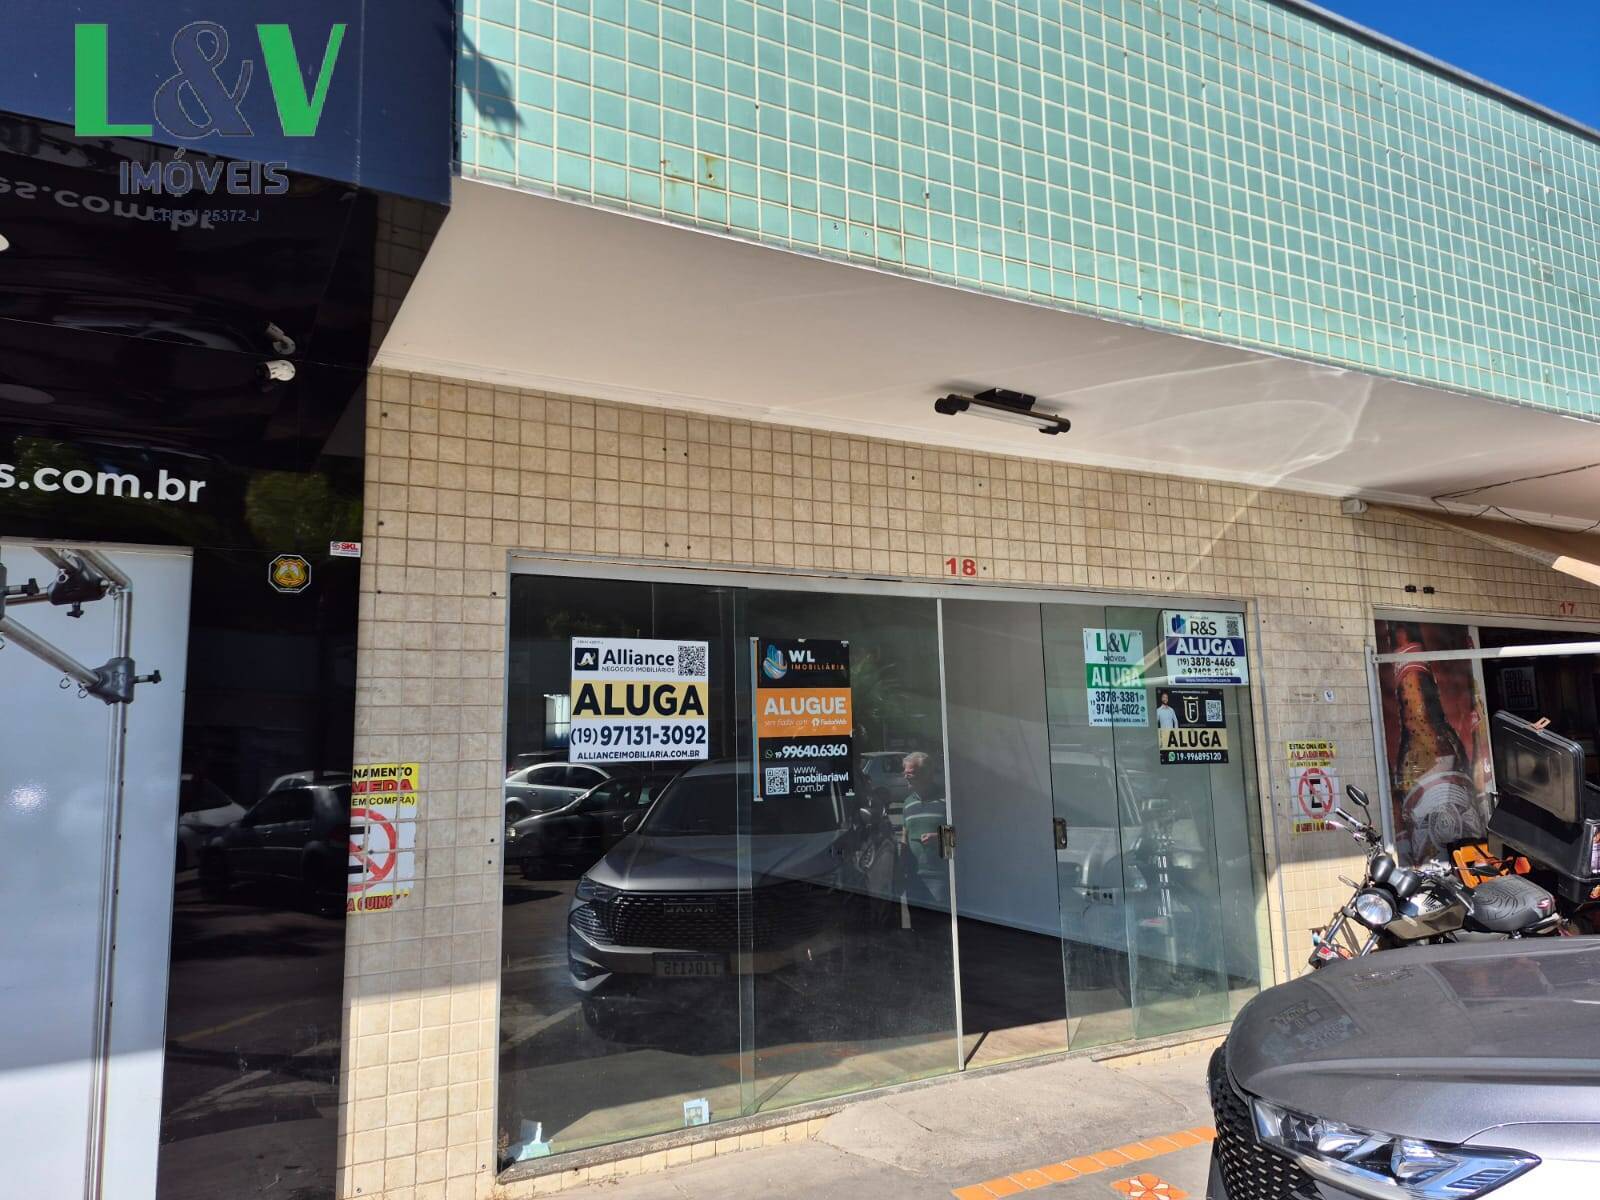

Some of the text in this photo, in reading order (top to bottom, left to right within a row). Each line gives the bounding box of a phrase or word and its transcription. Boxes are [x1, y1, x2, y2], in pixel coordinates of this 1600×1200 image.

[946, 557, 976, 576] 18
[1560, 601, 1575, 615] 17
[1190, 621, 1217, 636] R&S
[1096, 632, 1131, 653] L&V
[1176, 637, 1236, 656] ALUGA
[602, 648, 675, 666] Alliance
[788, 649, 816, 663] WL
[1190, 657, 1236, 667] 3878-4466
[1091, 666, 1142, 688] ALUGA
[572, 683, 705, 716] ALUGA
[1095, 691, 1140, 703] 3878-3381
[764, 696, 848, 716] ALUGUE
[571, 725, 706, 746] (19) 97131-3092
[1167, 730, 1222, 748] ALUGA
[577, 749, 700, 760] ALLIANCEIMOBILIARIA.COM.BR
[782, 743, 848, 759] 99640.6360
[794, 772, 849, 784] imobiliariawl
[793, 783, 825, 793] .com.br
